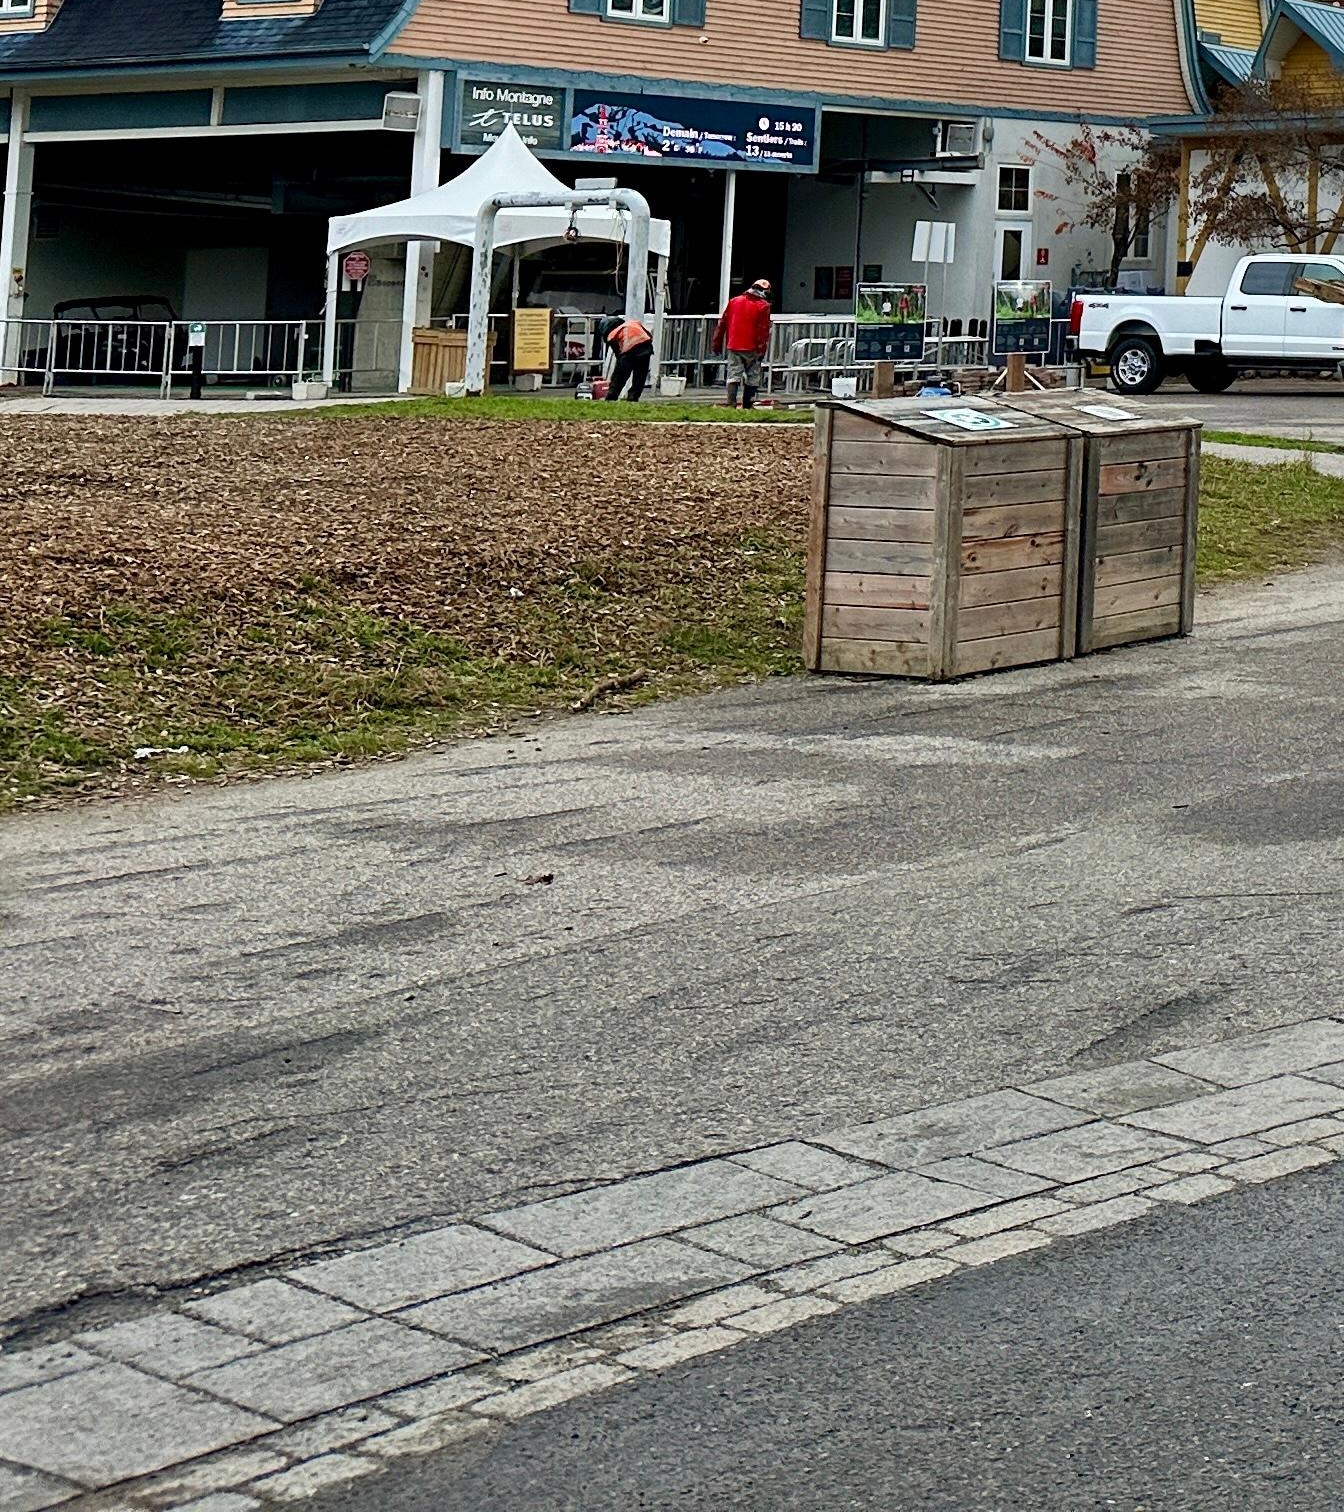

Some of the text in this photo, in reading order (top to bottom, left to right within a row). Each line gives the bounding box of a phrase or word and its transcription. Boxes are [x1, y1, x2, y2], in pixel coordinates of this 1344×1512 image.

[472, 87, 554, 107] Info Montagne
[502, 112, 554, 127] TELUS
[662, 125, 699, 139] Demain
[746, 132, 784, 145] Sentiers
